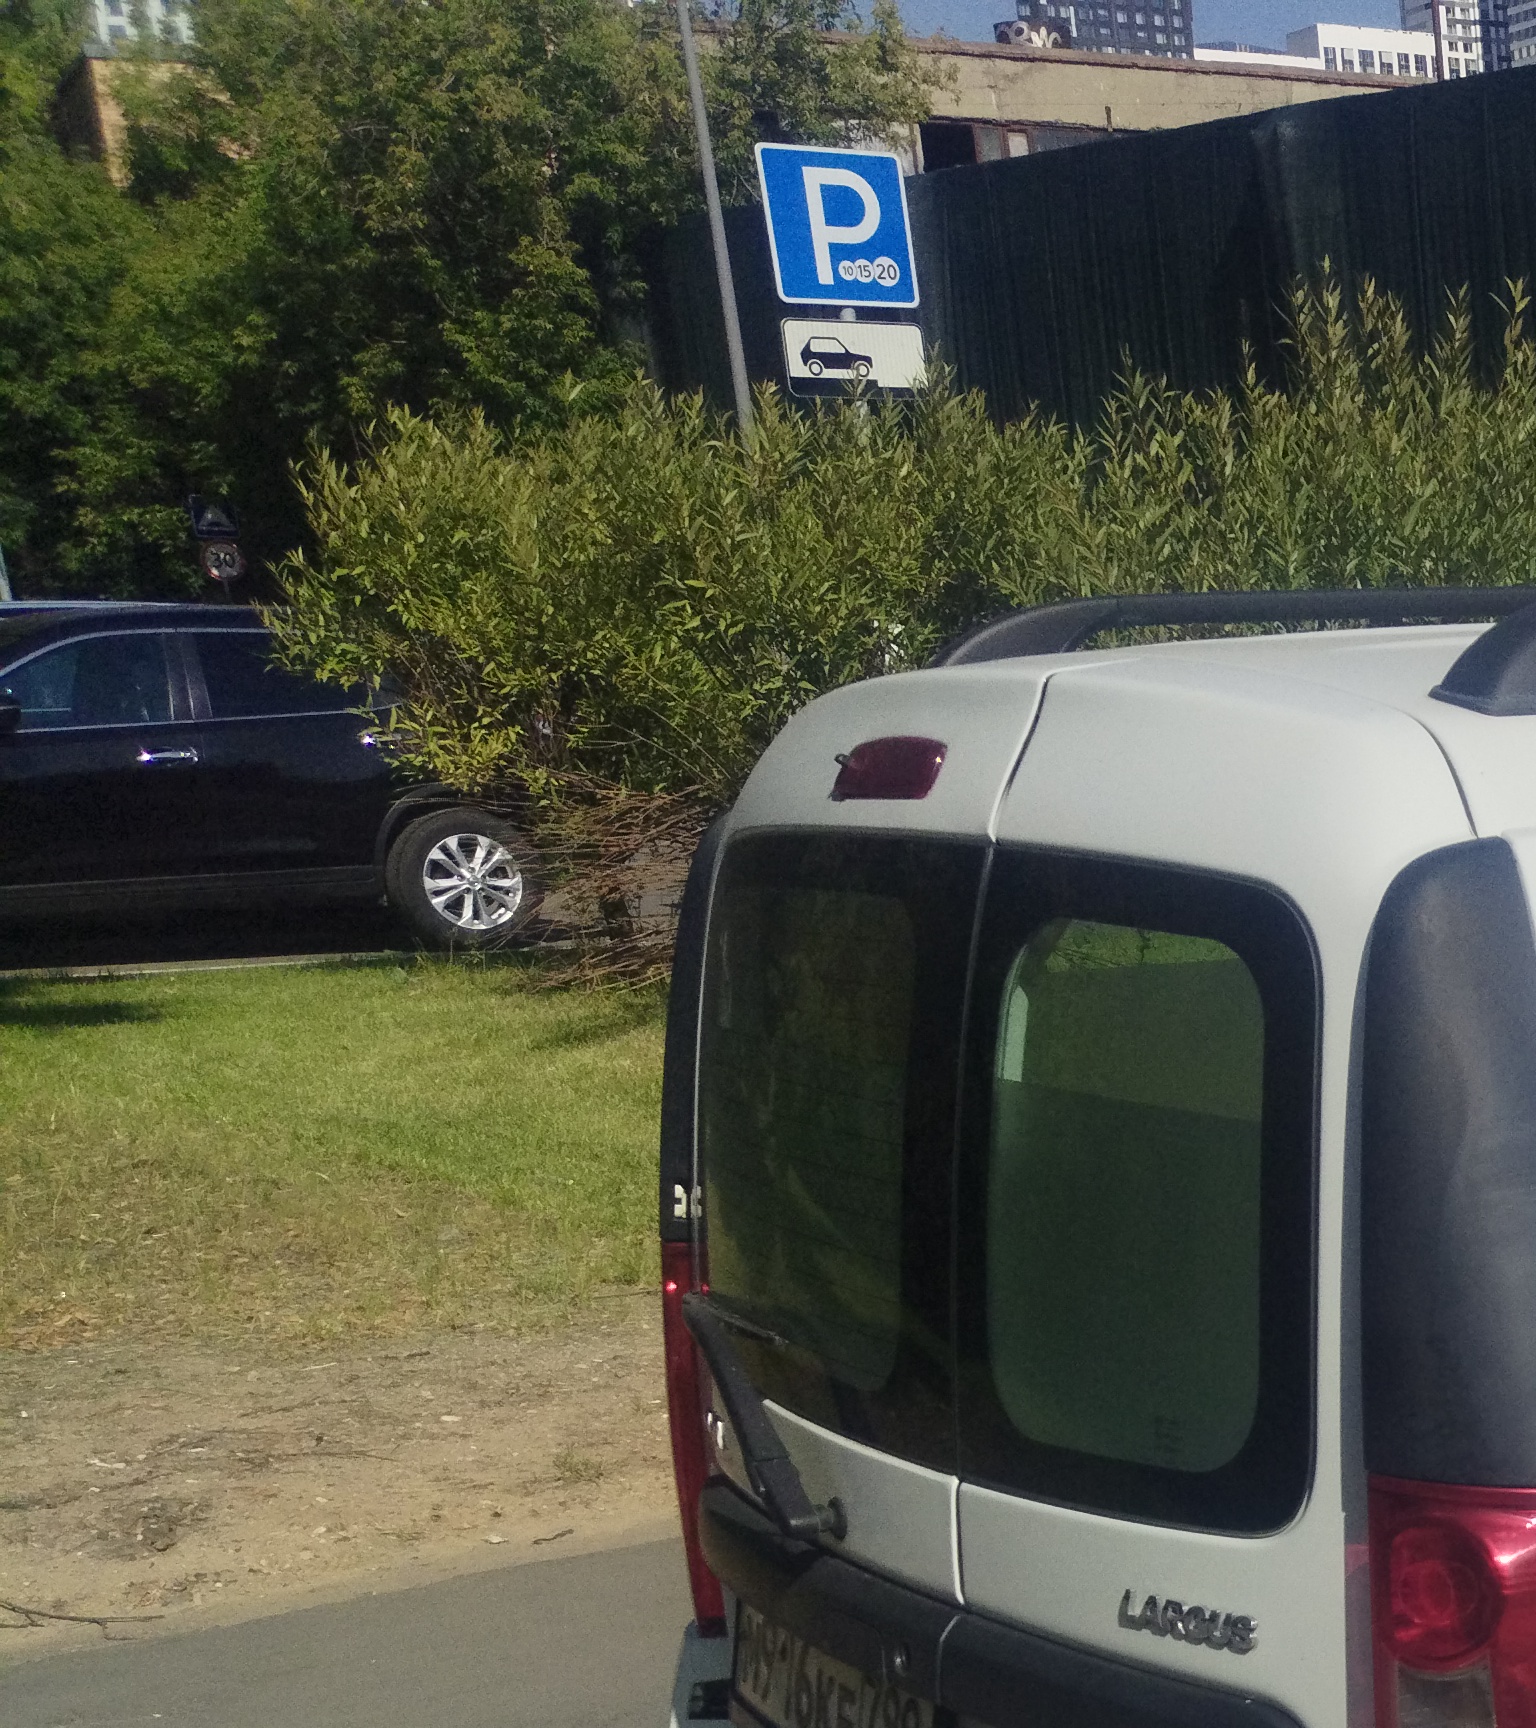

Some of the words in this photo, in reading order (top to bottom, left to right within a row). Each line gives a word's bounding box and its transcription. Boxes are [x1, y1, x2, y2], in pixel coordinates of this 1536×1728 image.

[802, 166, 881, 286] P
[842, 265, 854, 277] 10
[858, 263, 872, 279] 15
[876, 263, 897, 281] 20
[211, 551, 235, 569] 30
[1117, 1588, 1259, 1656] LARGUS
